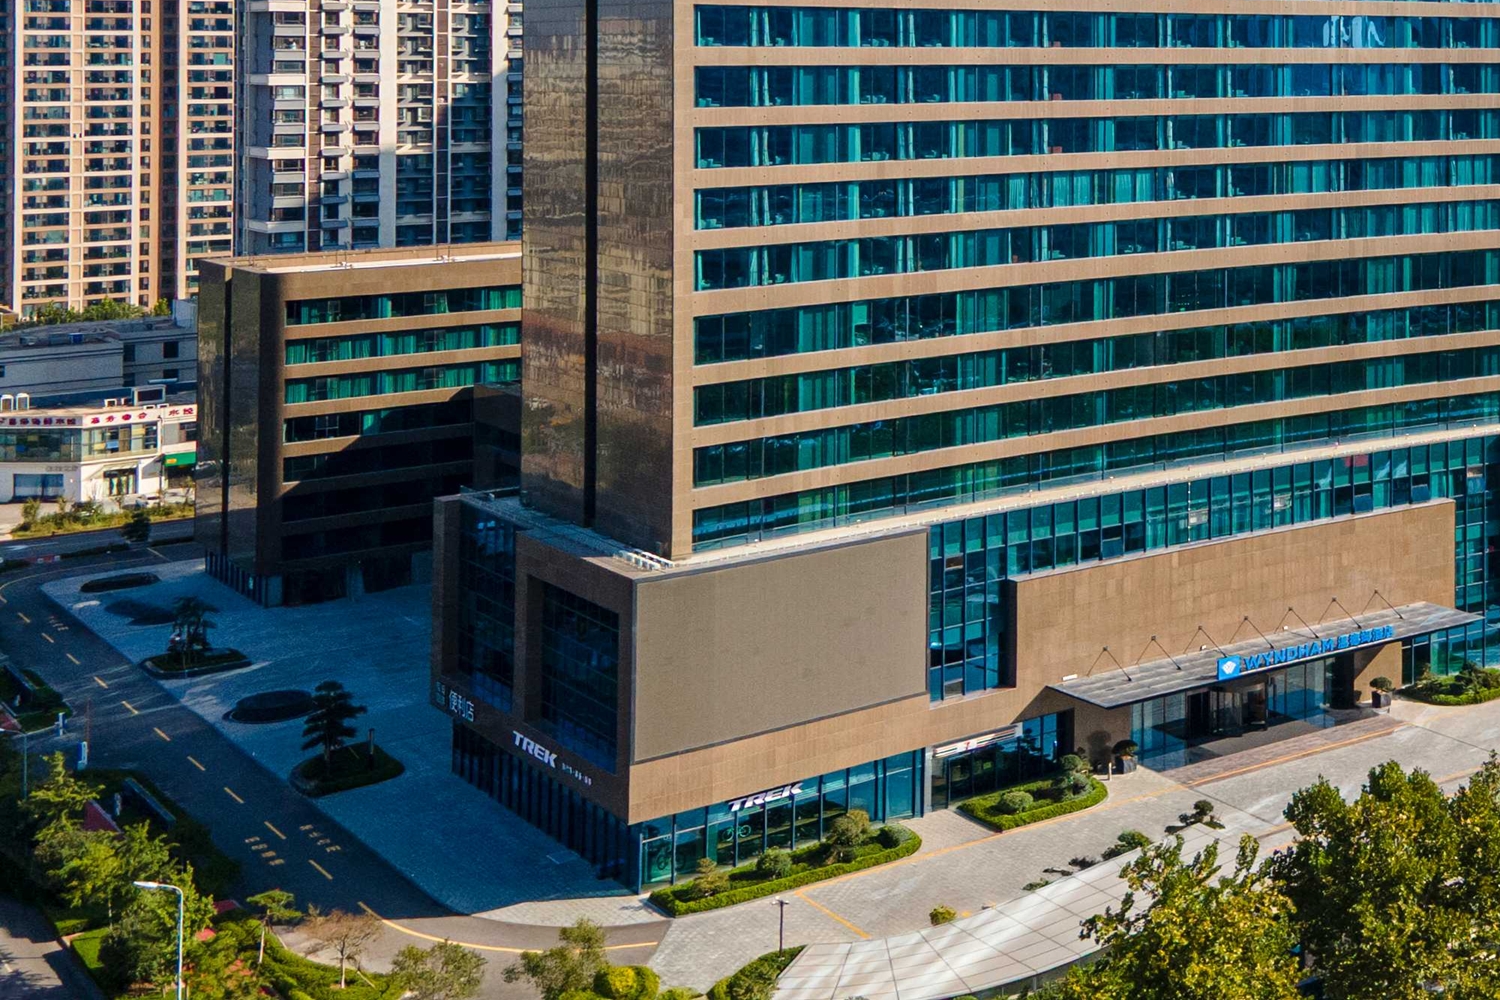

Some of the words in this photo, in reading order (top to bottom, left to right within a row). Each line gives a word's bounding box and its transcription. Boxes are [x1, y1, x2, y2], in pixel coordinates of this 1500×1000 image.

[1244, 637, 1334, 670] WYNDHAM
[449, 689, 475, 722] 便利店
[512, 730, 557, 768] TREK
[728, 782, 805, 812] TREK
